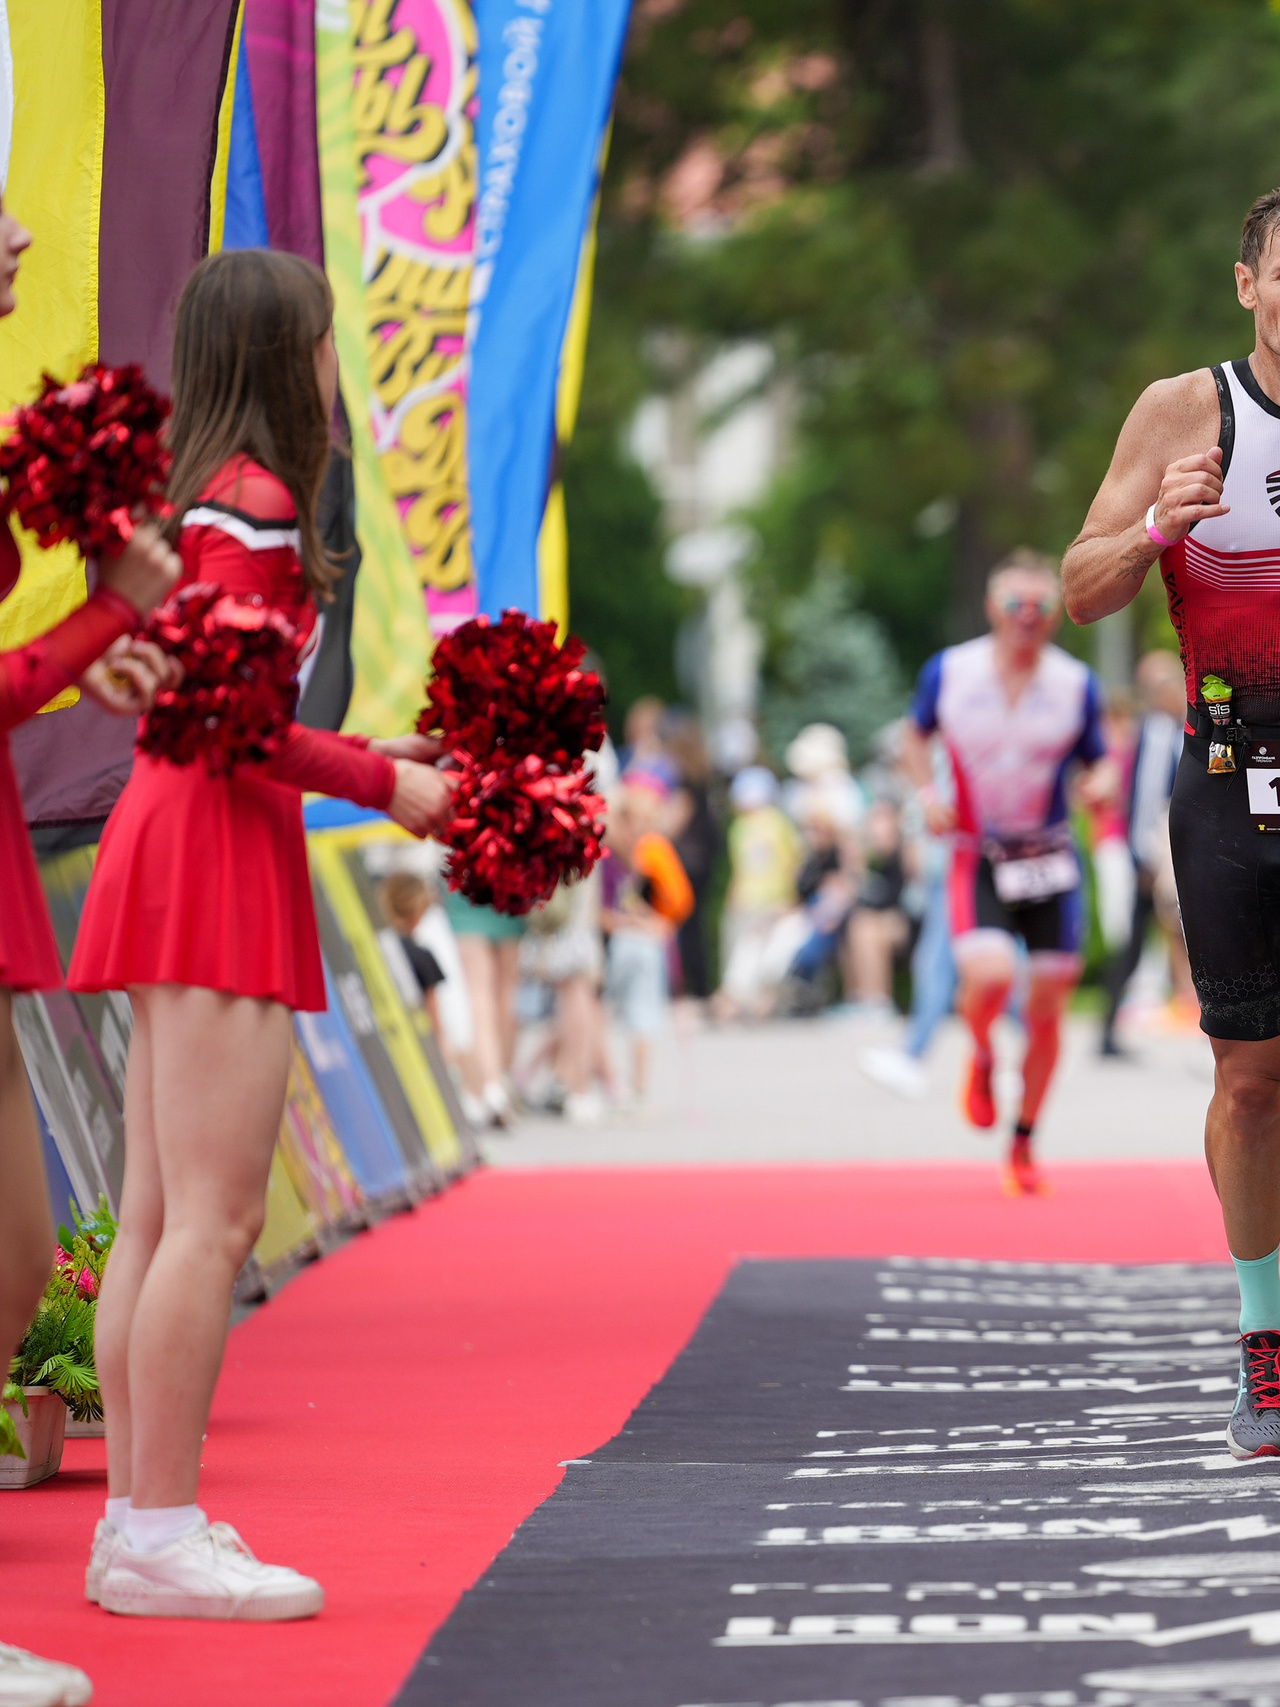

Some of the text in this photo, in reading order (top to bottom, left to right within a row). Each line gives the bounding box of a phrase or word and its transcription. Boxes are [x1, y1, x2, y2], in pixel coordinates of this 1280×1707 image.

[792, 1457, 1127, 1476] IRON
[766, 1517, 1142, 1541] IRON
[724, 1611, 1158, 1638] IRON
